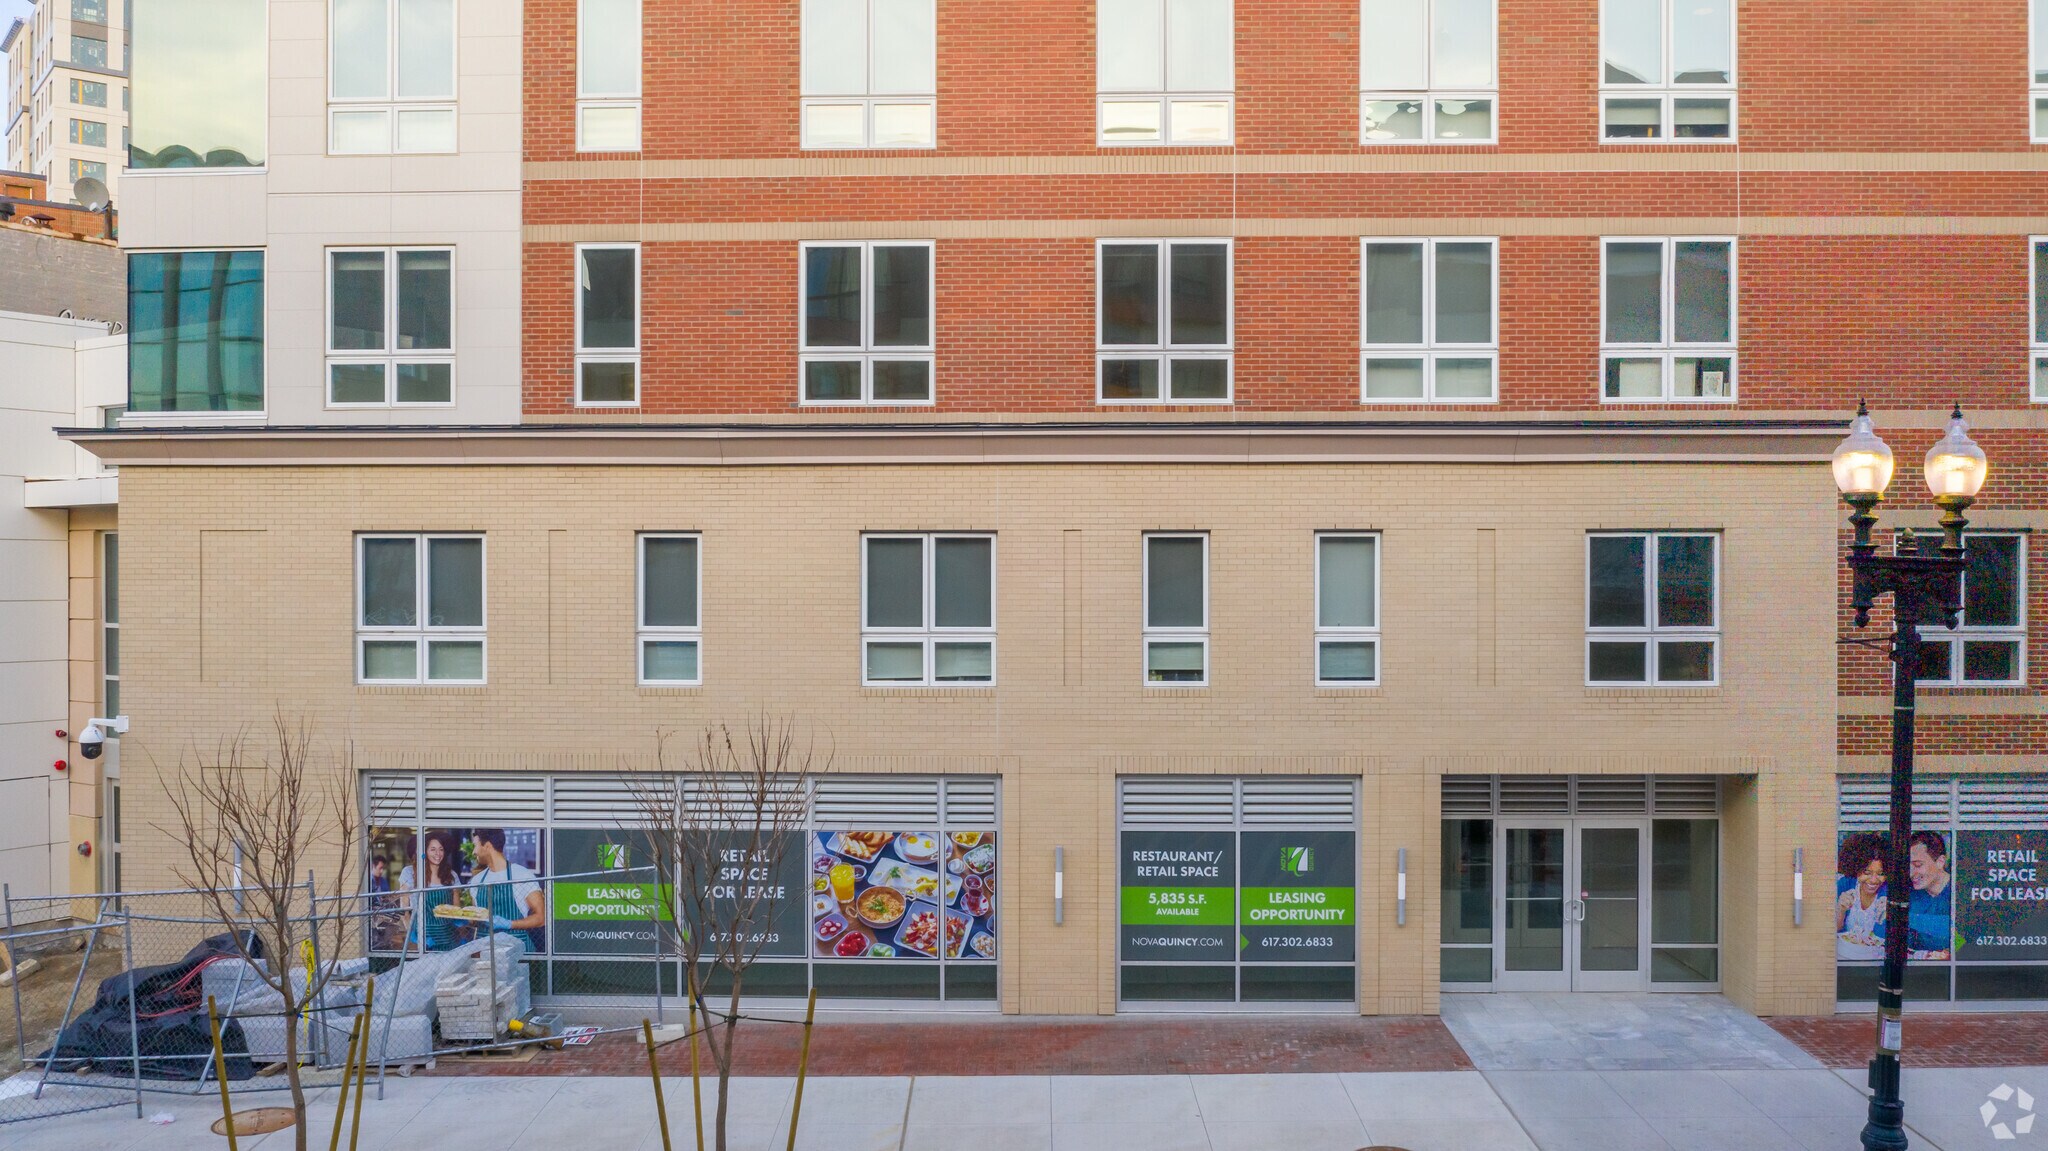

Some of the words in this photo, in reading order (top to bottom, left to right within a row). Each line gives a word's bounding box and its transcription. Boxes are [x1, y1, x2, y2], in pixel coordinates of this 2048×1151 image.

[1133, 850, 1223, 864] RESTAURANT/
[1987, 849, 2039, 863] RETAIL
[1137, 866, 1178, 877] RETAIL
[1180, 866, 1219, 877] SPACE
[1988, 868, 2037, 882] SPACE
[587, 888, 642, 899] LEASING
[705, 886, 736, 899] FOR
[741, 886, 785, 899] EASE
[1269, 892, 1326, 904] LEASING
[1971, 887, 2004, 901] FOR
[1148, 893, 1186, 905] 5,835
[1188, 894, 1207, 904] S.F.
[1156, 907, 1199, 916] AVAILABLE
[1250, 908, 1345, 921] OPPORTUNITY
[1132, 937, 1223, 947] NOVAQUINCY.COM
[1261, 937, 1334, 947] 617.302.6833
[1976, 936, 2047, 946] 617.302.6833
